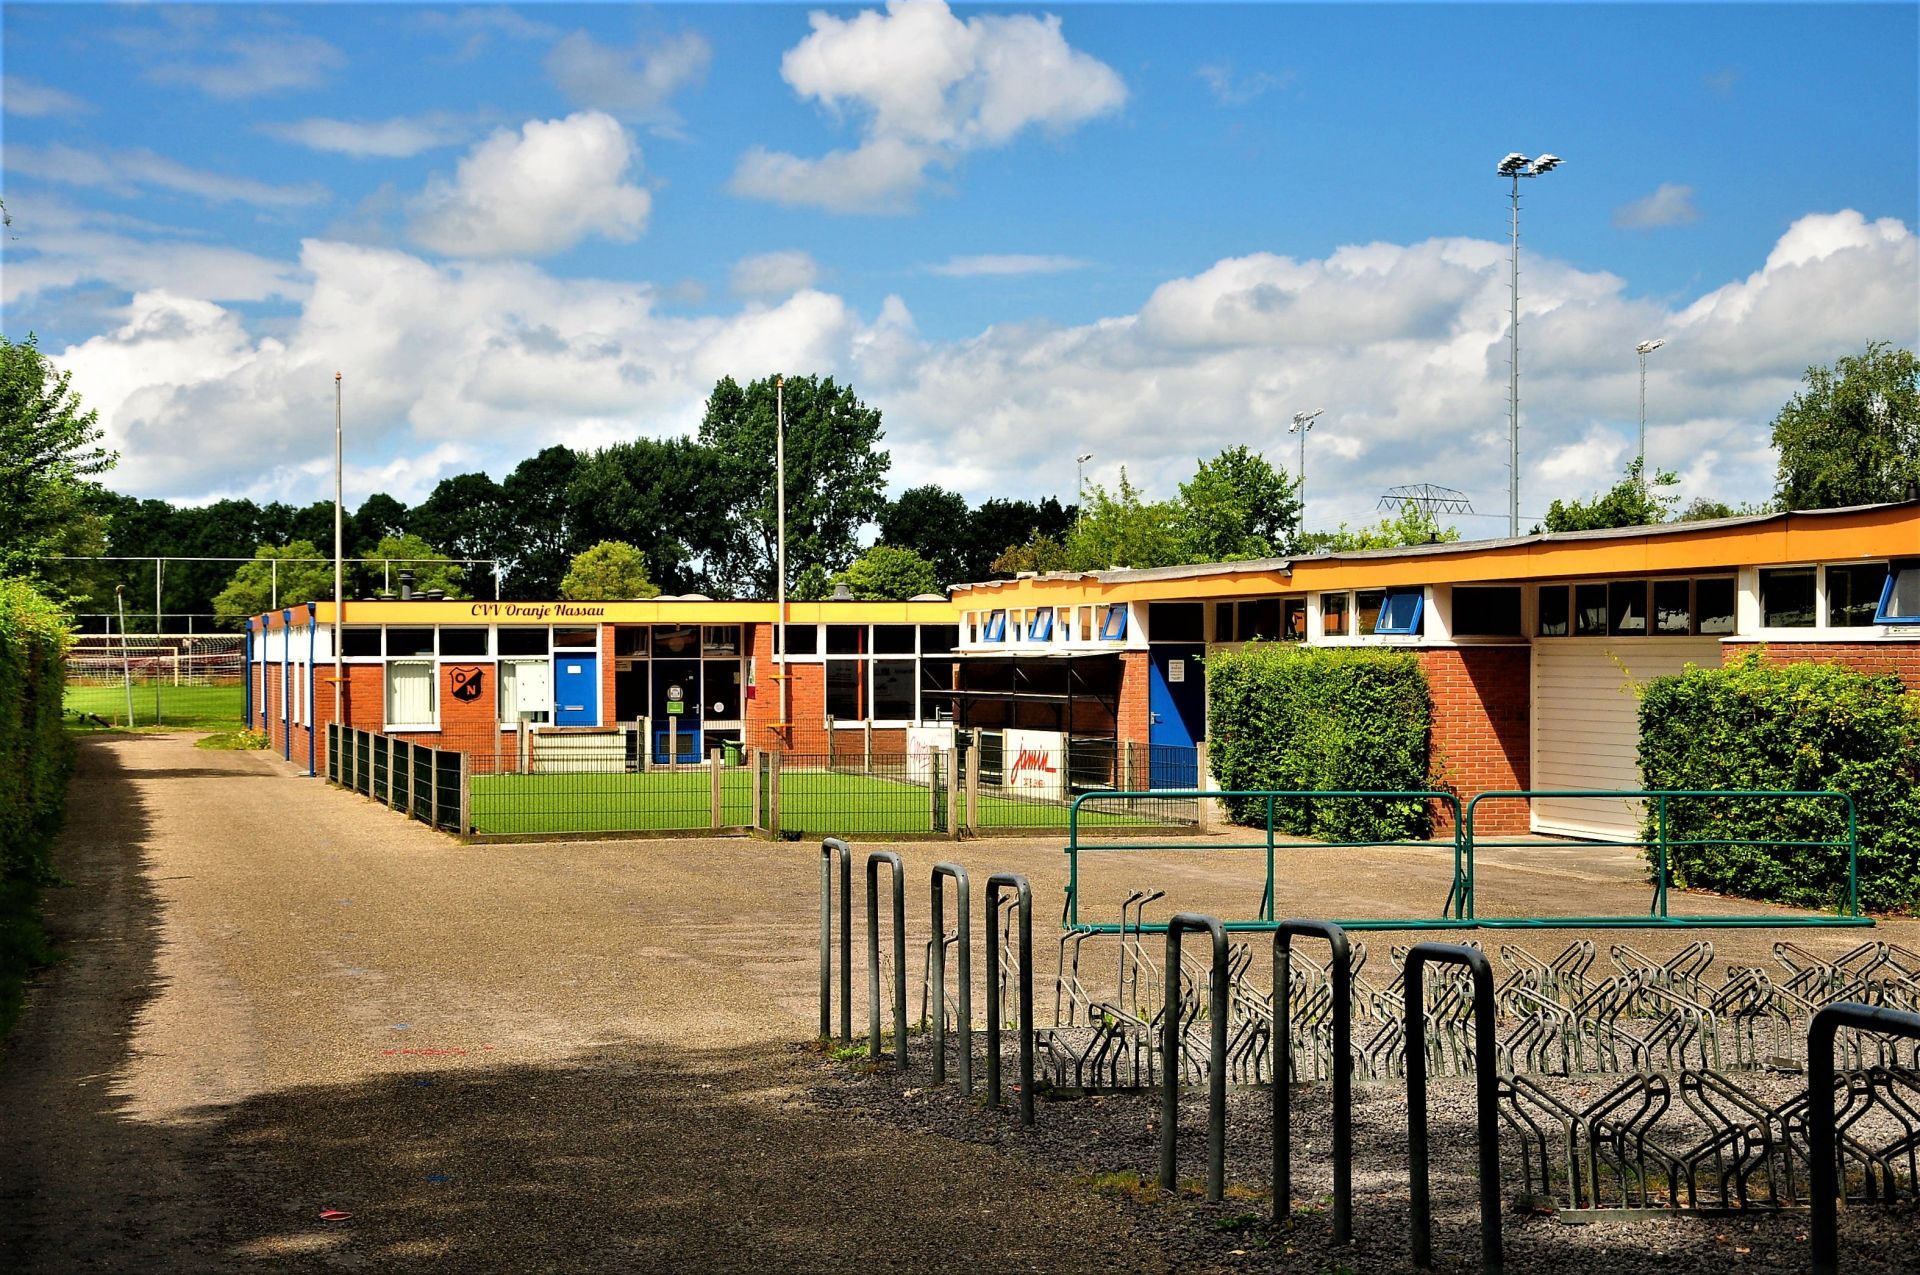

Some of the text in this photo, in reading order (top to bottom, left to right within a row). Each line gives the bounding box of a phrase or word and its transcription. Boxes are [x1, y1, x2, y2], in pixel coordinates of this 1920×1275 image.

[471, 604, 604, 619] CVV Oranje Nassau
[455, 673, 466, 684] O
[466, 685, 476, 695] N
